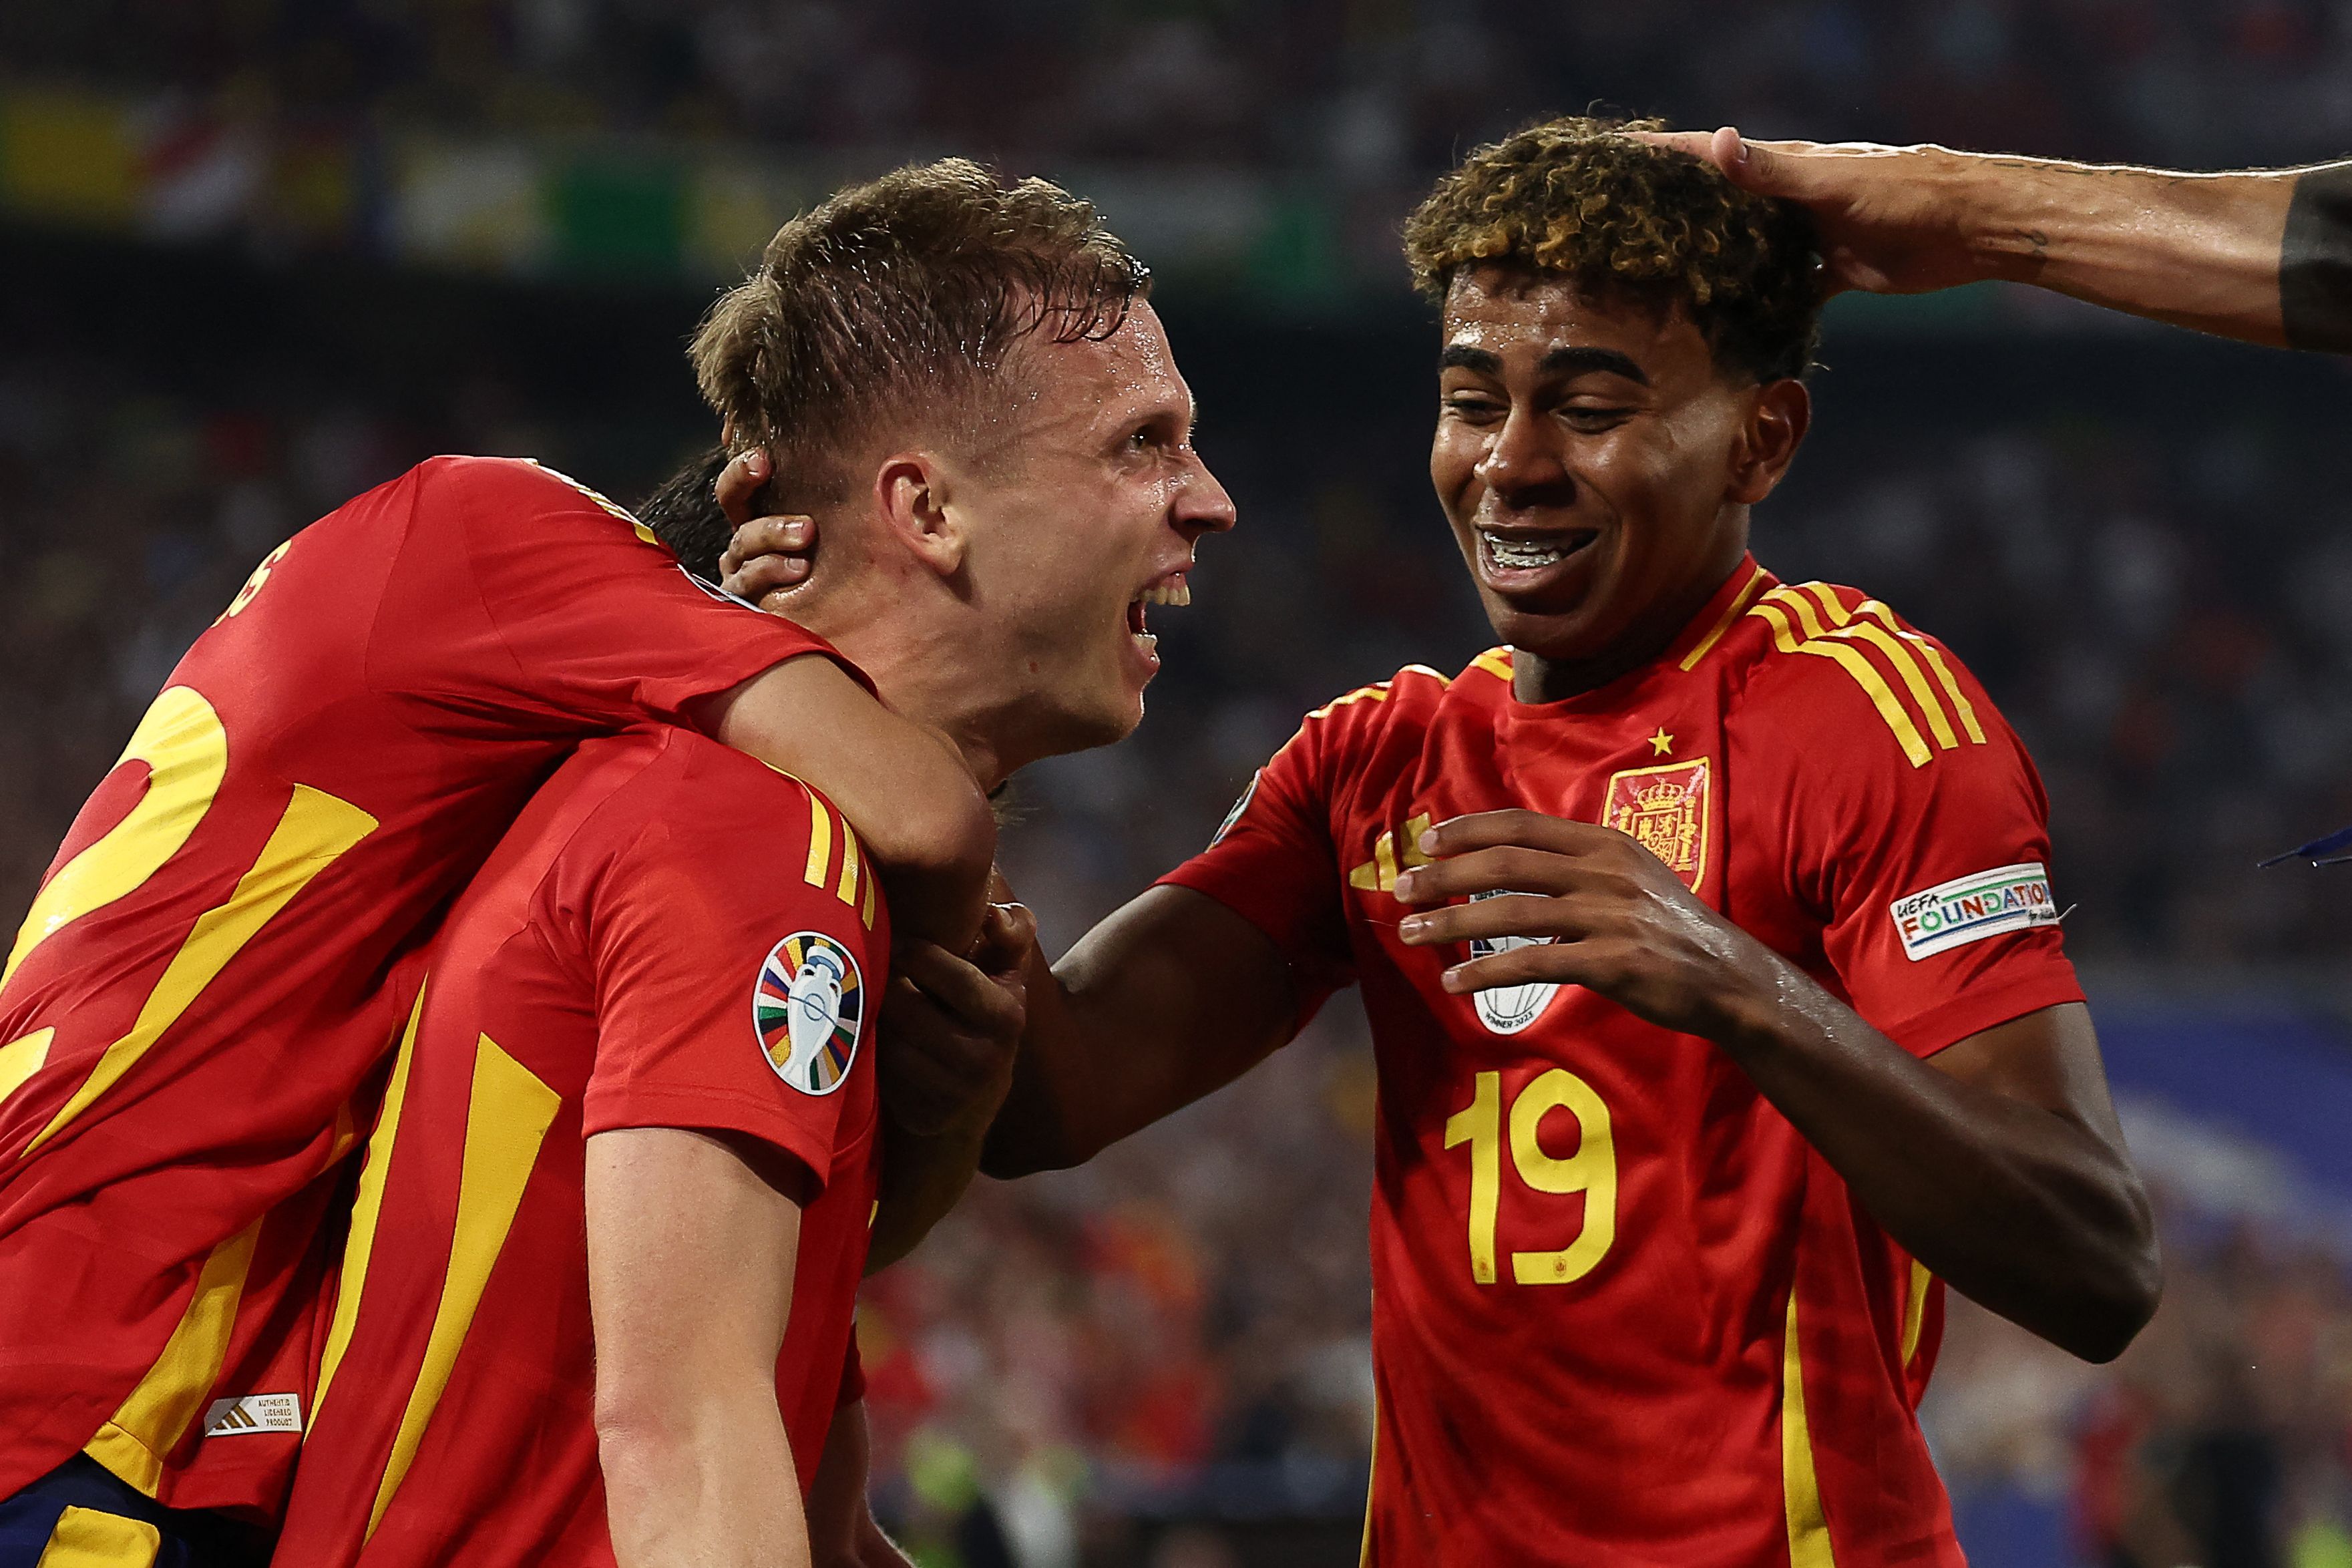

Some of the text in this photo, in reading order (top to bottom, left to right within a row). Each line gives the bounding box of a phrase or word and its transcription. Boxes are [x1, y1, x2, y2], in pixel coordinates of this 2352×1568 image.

[1898, 894, 1939, 917] UEFA
[1486, 1012, 1533, 1028] WINNER 2023
[1444, 1068, 1638, 1285] 19
